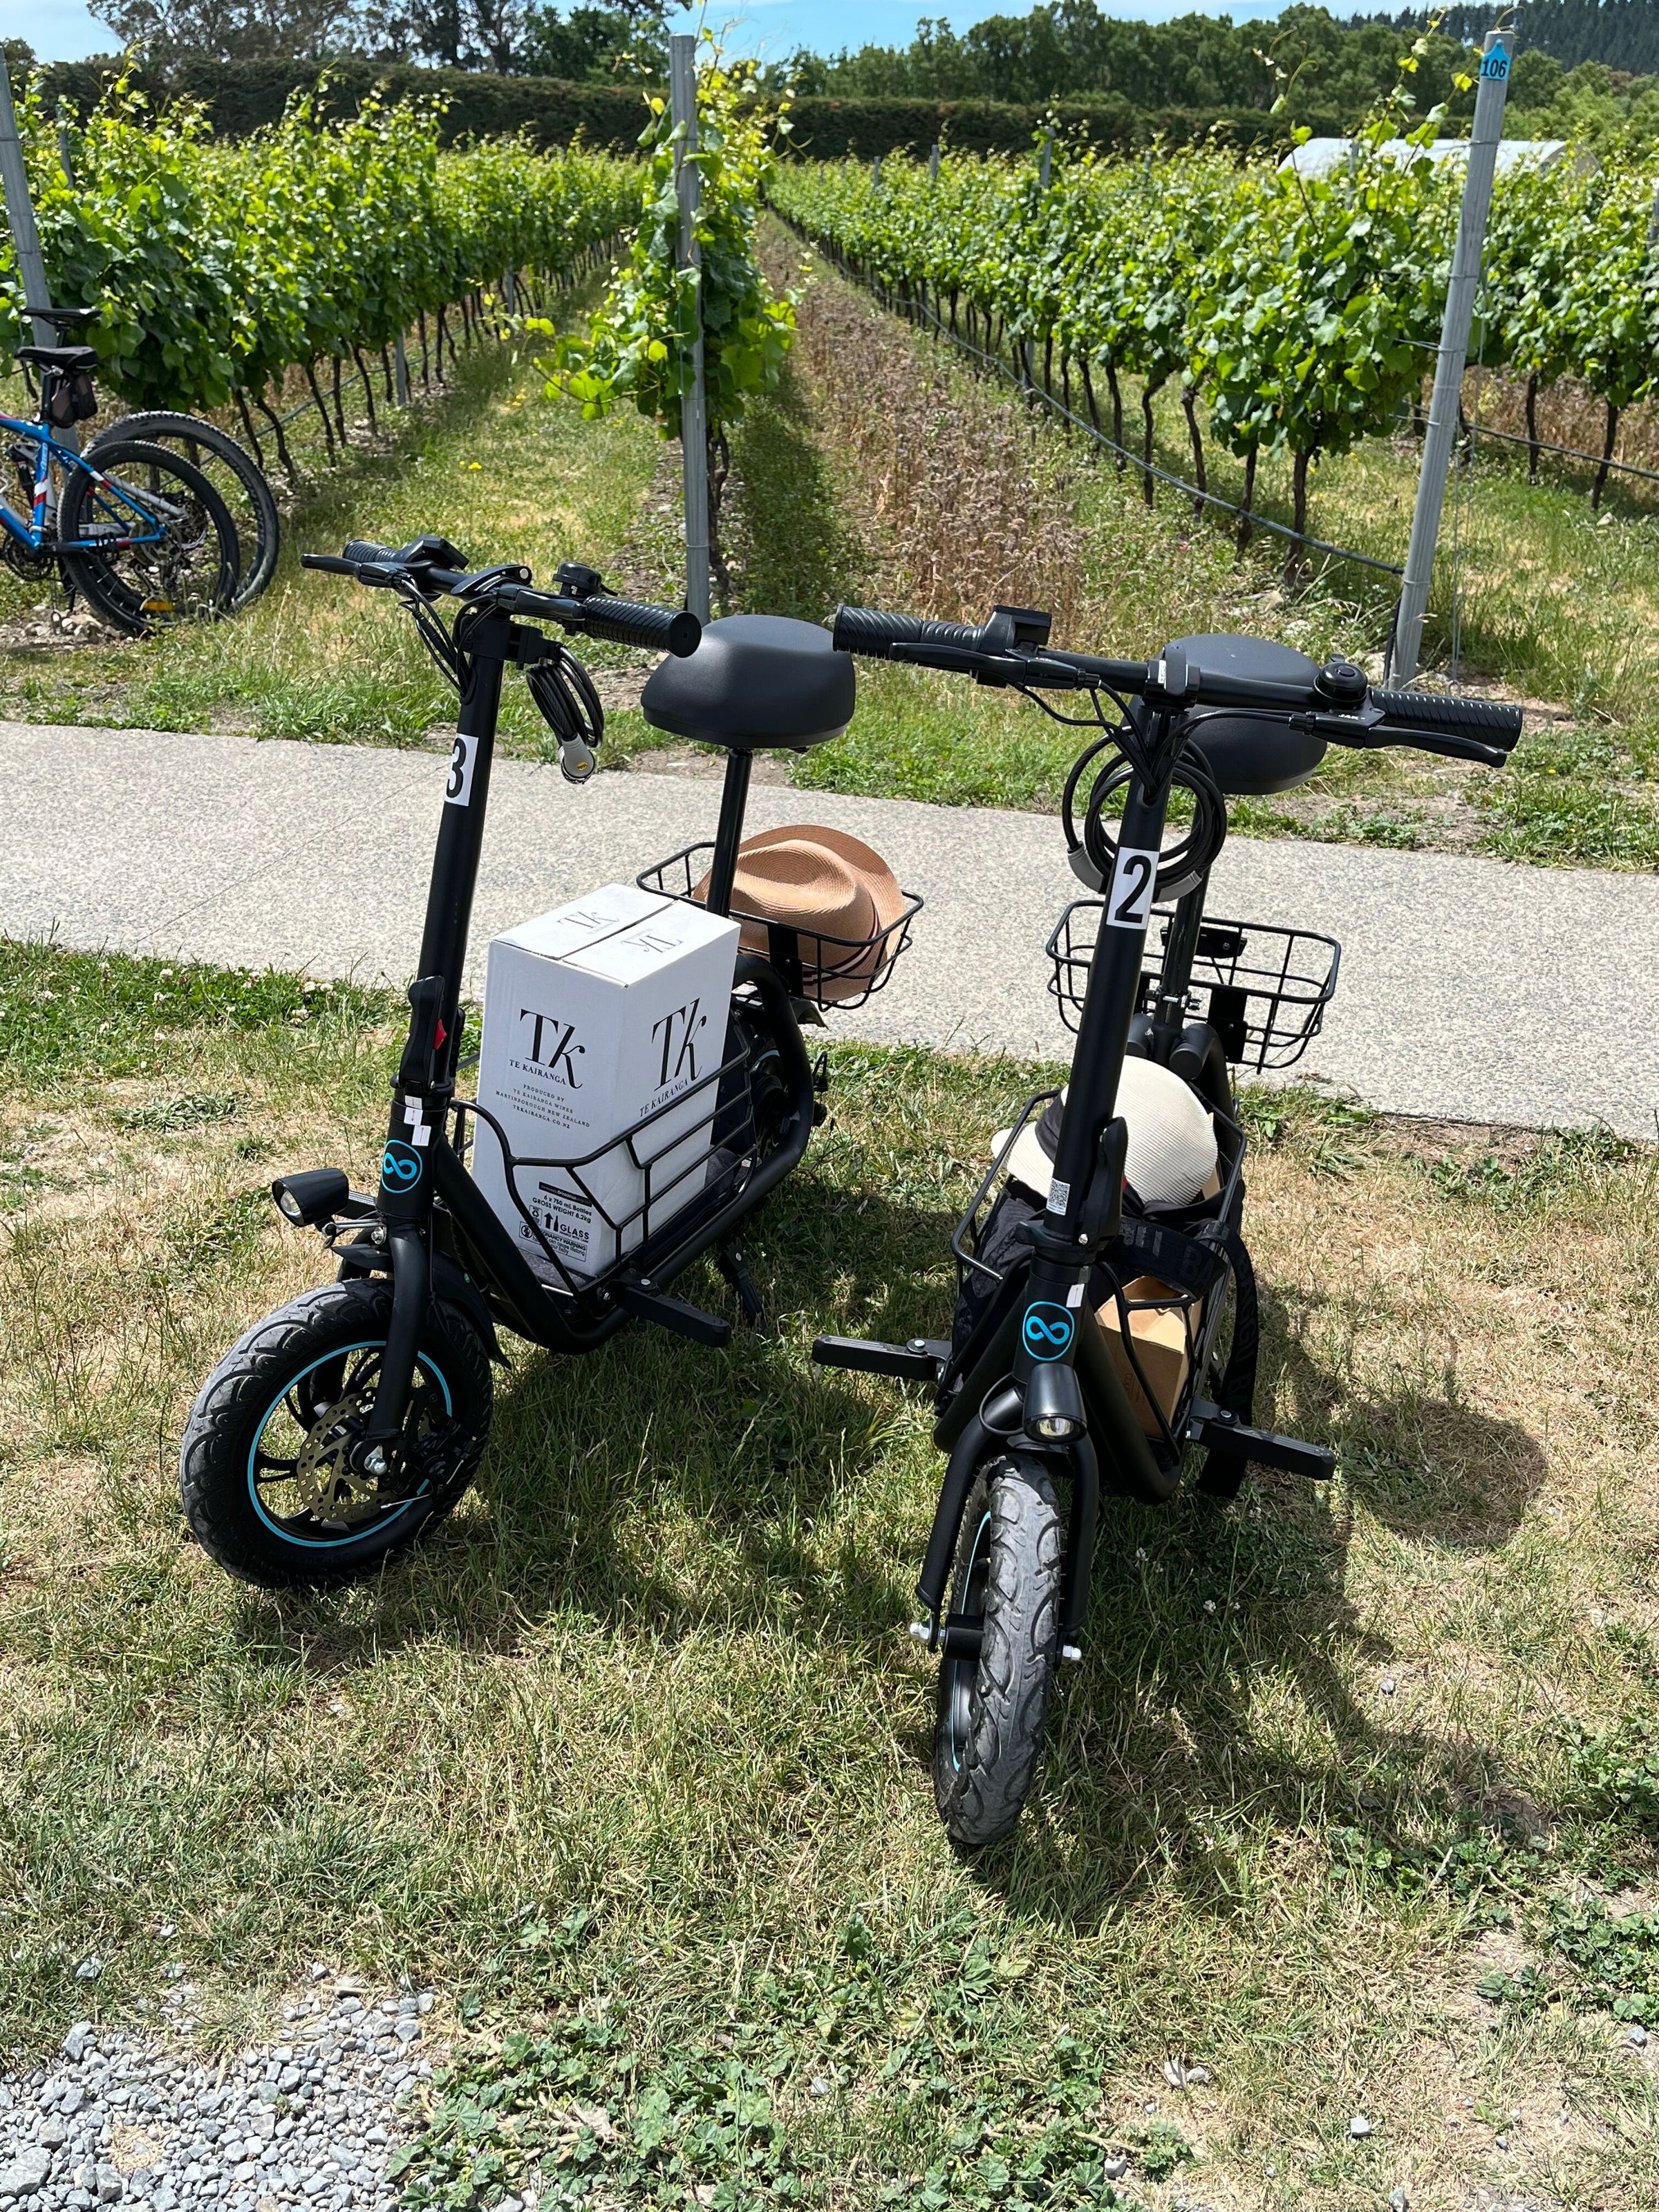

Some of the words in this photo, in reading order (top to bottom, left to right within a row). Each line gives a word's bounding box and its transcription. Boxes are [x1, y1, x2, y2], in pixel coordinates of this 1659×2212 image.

[1481, 58, 1508, 77] 106
[446, 737, 467, 798] 3
[1114, 854, 1152, 924] 2
[520, 1009, 586, 1089] Tk
[651, 997, 707, 1091] Tk
[509, 1059, 520, 1069] TE
[522, 1064, 566, 1086] KAIRANGA
[523, 1084, 555, 1099] PRODUCED
[523, 1092, 553, 1107] KAIRANGA
[554, 1103, 573, 1114] WINES
[639, 1103, 650, 1118] TE
[651, 1078, 688, 1110] KAIRANGA
[496, 1090, 545, 1112] MARTINBOROUGH
[547, 1109, 561, 1117] NEW
[562, 1114, 590, 1127] ZEALAND
[513, 1105, 570, 1129] TEKAIRANGA.CO.NZ
[532, 1197, 551, 1208] GROSS
[553, 1205, 574, 1217] WEIGHT
[575, 1213, 592, 1224] 8.2kg
[553, 1197, 563, 1206] 750
[572, 1205, 592, 1217] Bottles
[560, 1224, 590, 1240] GLASS
[563, 1237, 586, 1251] WARNING
